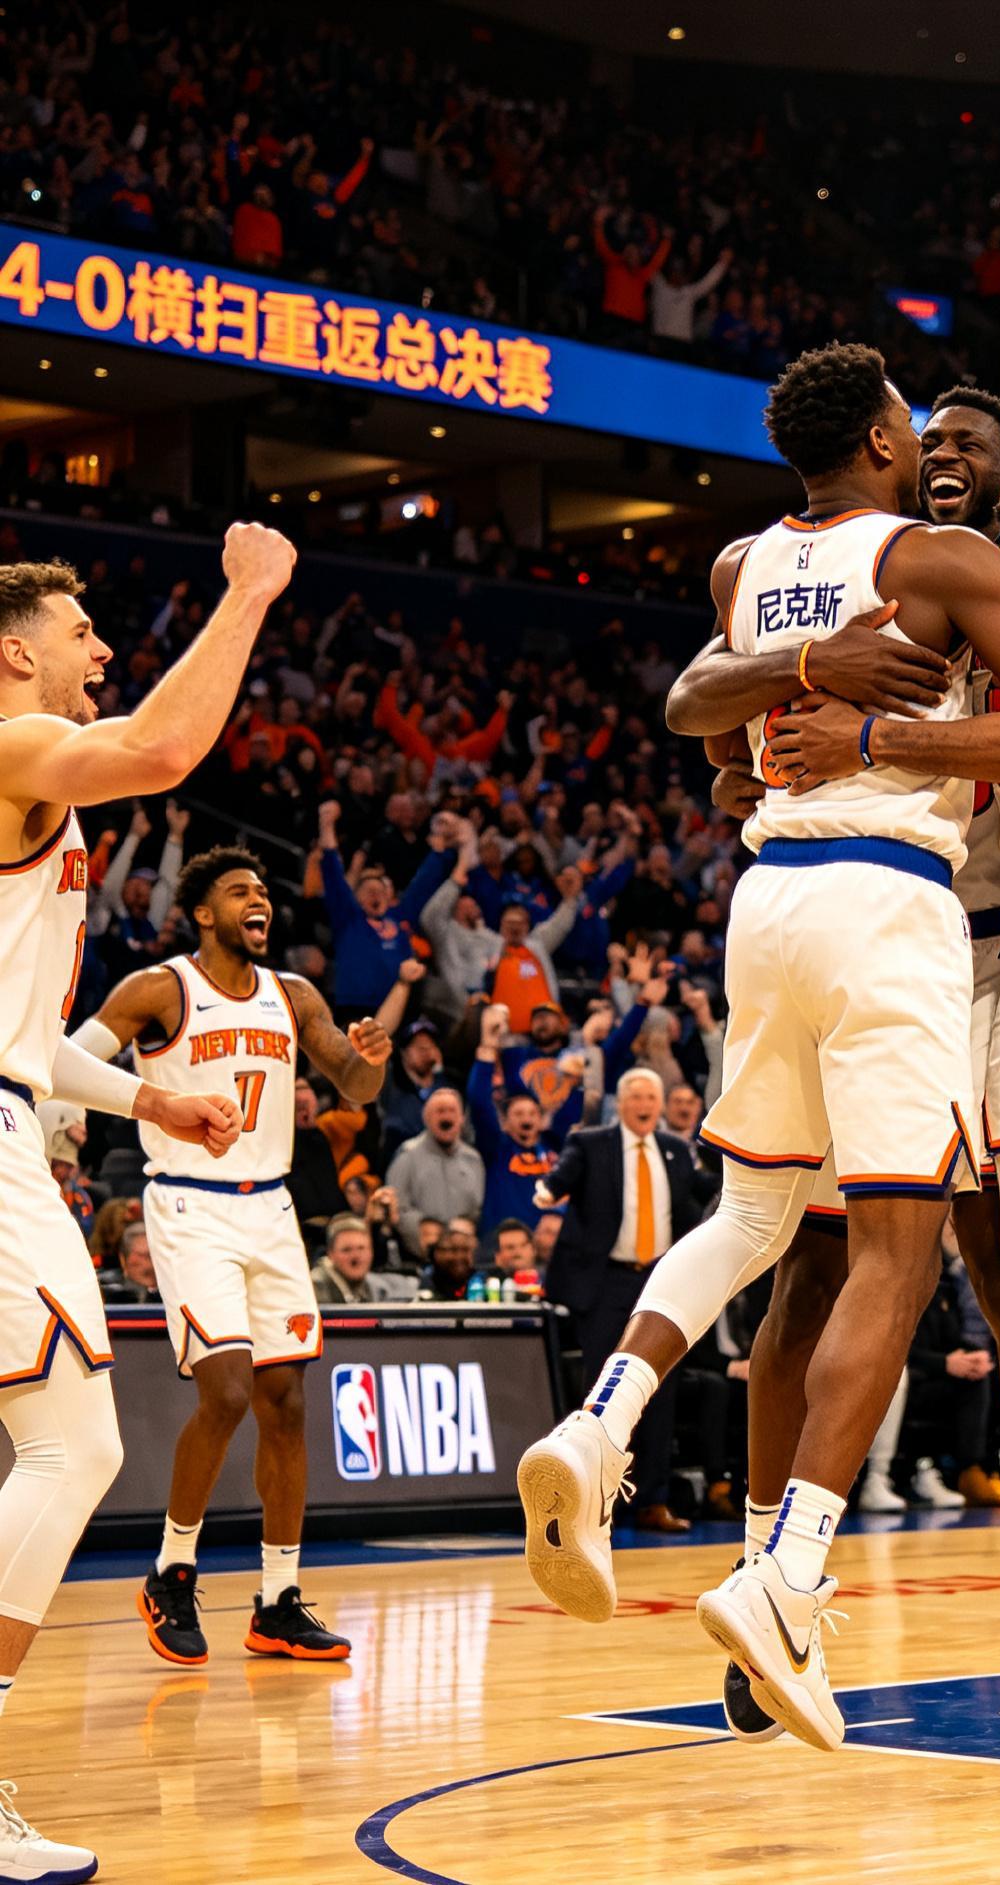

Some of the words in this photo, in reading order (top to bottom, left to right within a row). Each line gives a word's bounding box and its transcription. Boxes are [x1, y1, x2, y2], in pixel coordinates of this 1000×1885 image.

[0, 241, 552, 414] 4-0横扫重返总决赛
[757, 582, 845, 638] 尼克斯
[381, 1362, 496, 1476] NBA
